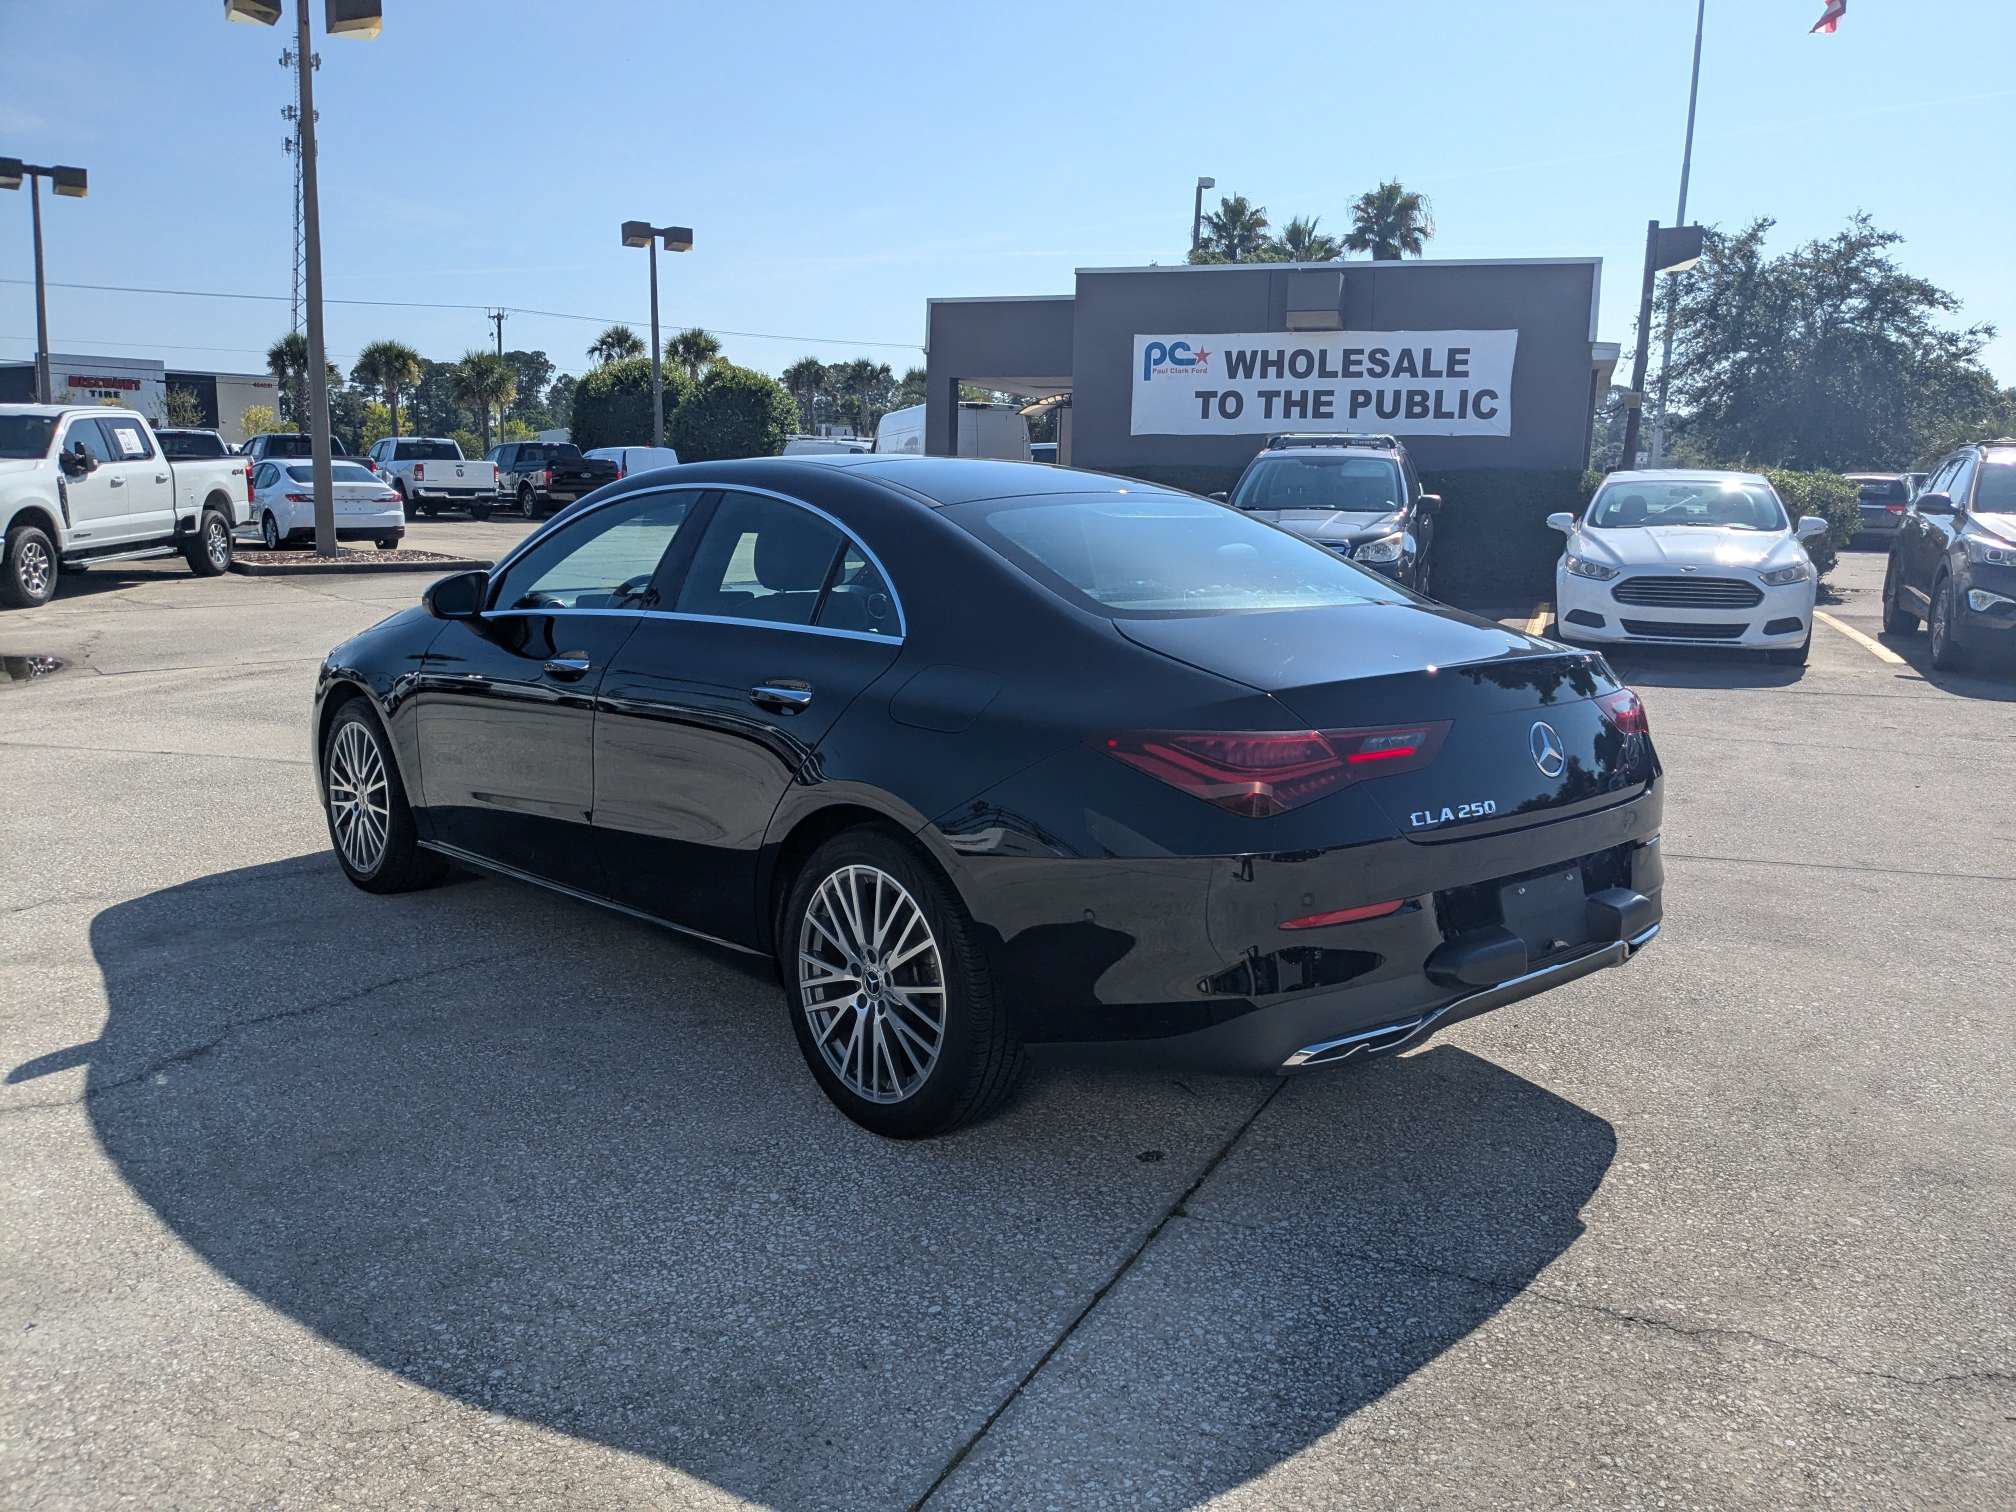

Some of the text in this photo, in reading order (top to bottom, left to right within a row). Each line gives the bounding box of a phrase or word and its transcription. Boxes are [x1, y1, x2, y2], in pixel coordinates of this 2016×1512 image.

[1224, 348, 1471, 379] WHOLESALE
[89, 390, 121, 399] TIRE
[1194, 389, 1499, 420] TO THE PUBLIC
[1410, 800, 1497, 827] CLA 250
